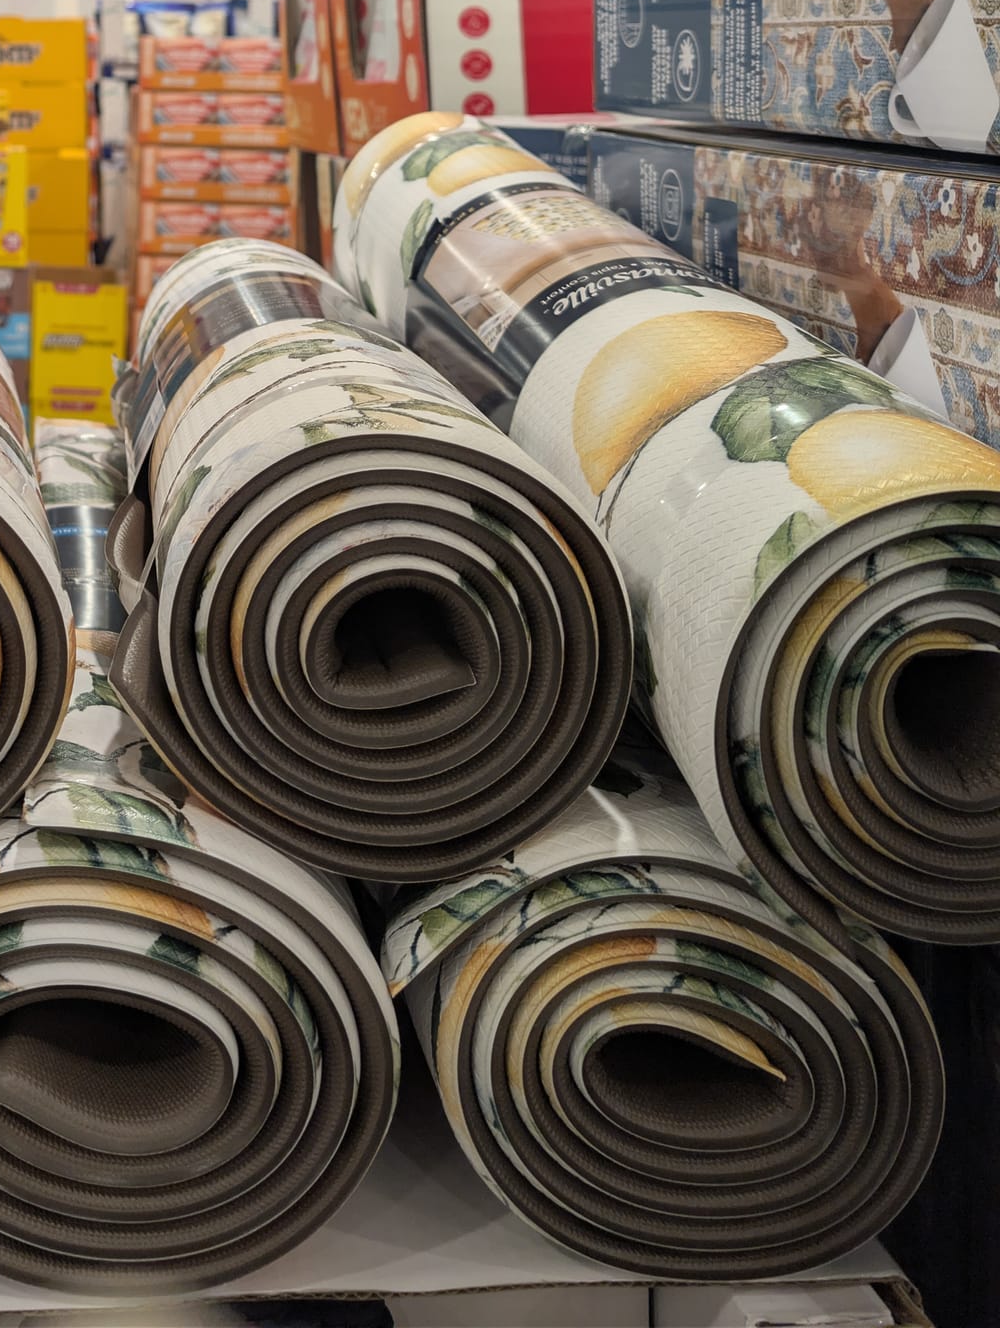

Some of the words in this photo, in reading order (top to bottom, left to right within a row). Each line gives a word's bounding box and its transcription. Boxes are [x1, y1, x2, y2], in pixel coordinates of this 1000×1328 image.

[591, 263, 626, 277] Tapis
[540, 275, 589, 306] Confort
[552, 268, 716, 317] omasville
